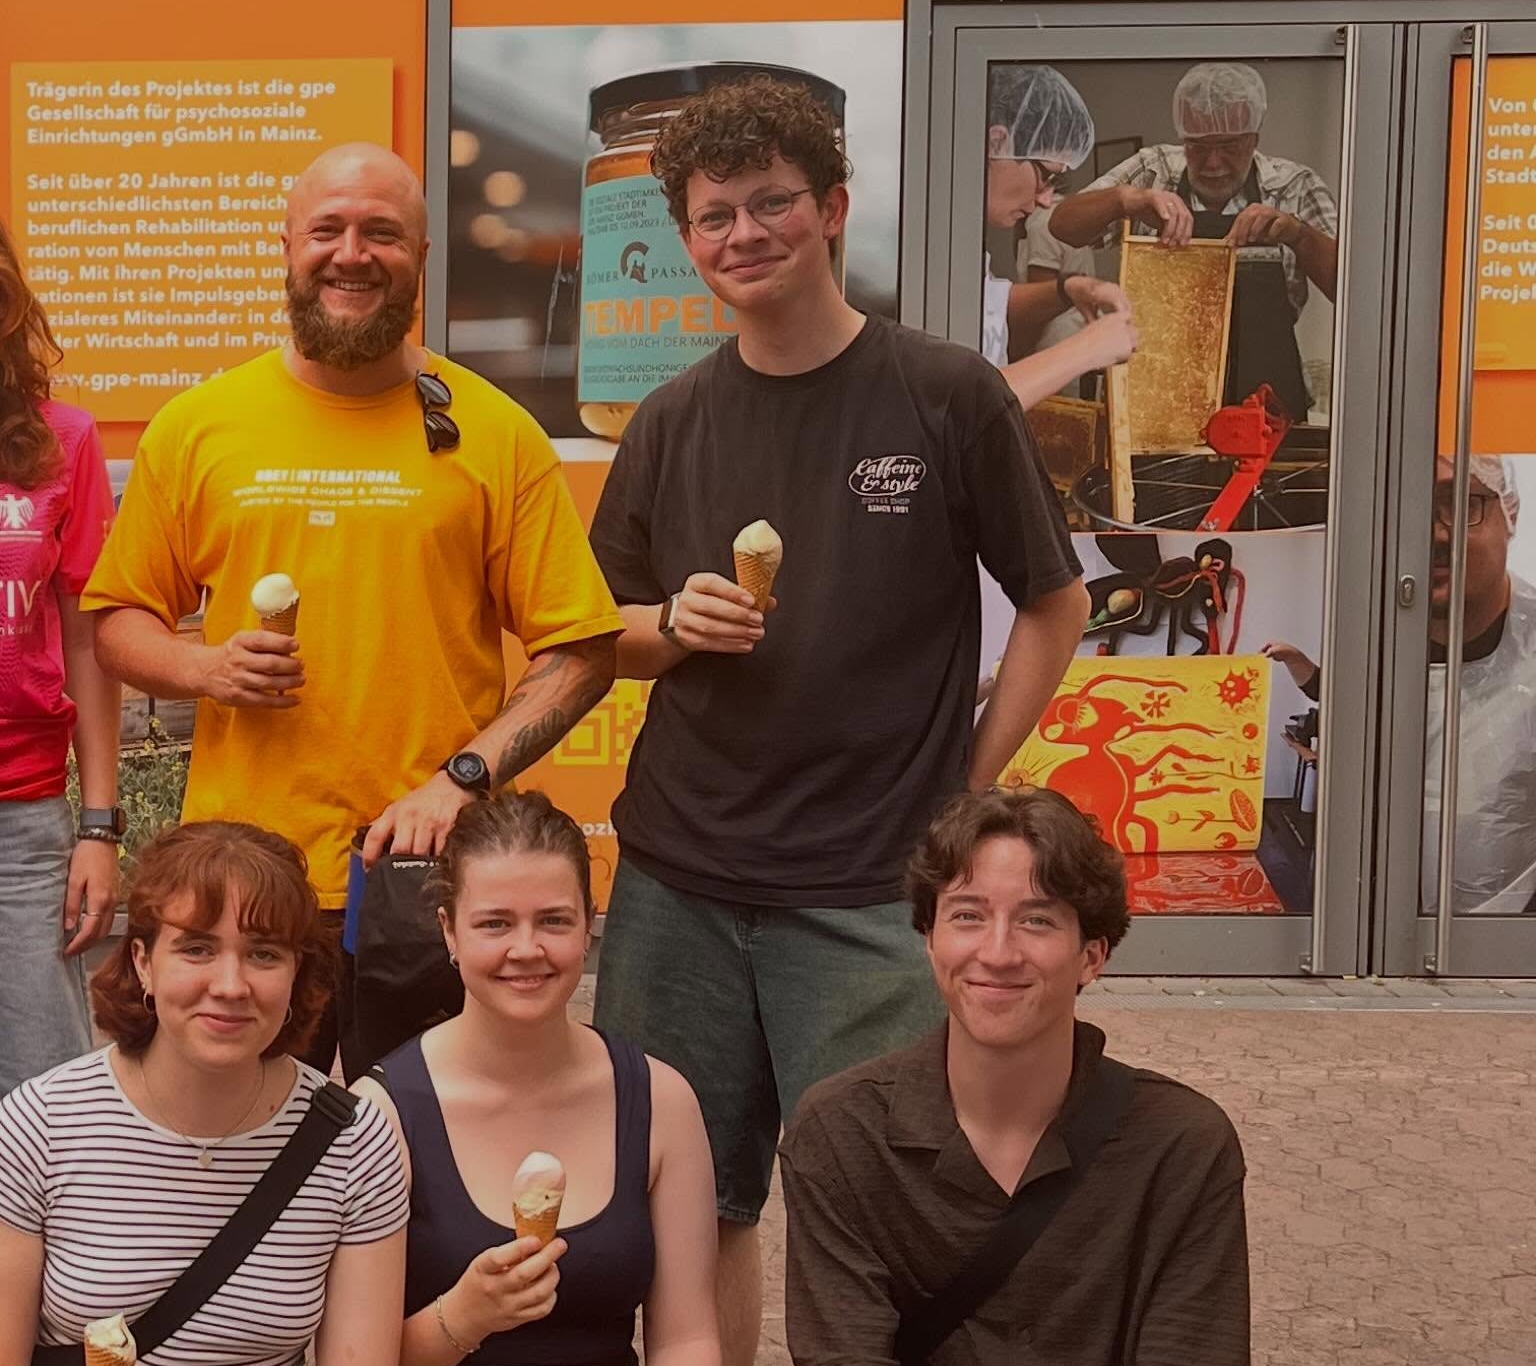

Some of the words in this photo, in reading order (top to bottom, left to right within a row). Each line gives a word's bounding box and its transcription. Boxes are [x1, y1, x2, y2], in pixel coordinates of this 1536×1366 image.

[27, 81, 103, 101] Trägerin
[108, 81, 141, 97] des
[146, 80, 232, 101] Projektes
[238, 80, 260, 95] ist
[265, 79, 294, 95] die
[300, 82, 336, 99] gpe
[27, 104, 139, 121] Gesellschaft
[144, 103, 170, 120] für
[176, 102, 306, 123] psychosoziale
[1488, 98, 1526, 113] Von
[27, 128, 157, 147] Einrichtungen
[162, 126, 233, 147] gGmbH
[238, 126, 256, 141] in
[260, 125, 323, 141] Mainz.
[1486, 144, 1524, 160] den
[27, 173, 63, 190] Seit
[69, 173, 112, 190] über
[118, 173, 143, 189] 20
[148, 172, 212, 188] Jahren
[217, 171, 241, 187] ist
[246, 171, 276, 187] die
[27, 195, 212, 213] unterschiedlichsten
[27, 218, 130, 235] beruflichen
[135, 217, 263, 234] Rehabilitation
[1483, 214, 1521, 231] Seit
[28, 242, 80, 258] ration
[84, 246, 118, 258] von
[124, 241, 216, 258] Menschen
[221, 241, 251, 256] mit
[79, 265, 109, 281] Mit
[167, 263, 256, 283] Projekten
[1481, 260, 1512, 277] die
[113, 288, 134, 303] ist
[139, 287, 165, 303] sie
[123, 309, 242, 325] Miteinander:
[248, 309, 265, 324] in
[85, 332, 179, 348] Wirtschaft
[184, 331, 219, 347] und
[630, 338, 660, 349] DACH
[664, 338, 688, 348] DER
[295, 469, 401, 484] INTERNATIONAL
[860, 474, 881, 492] &
